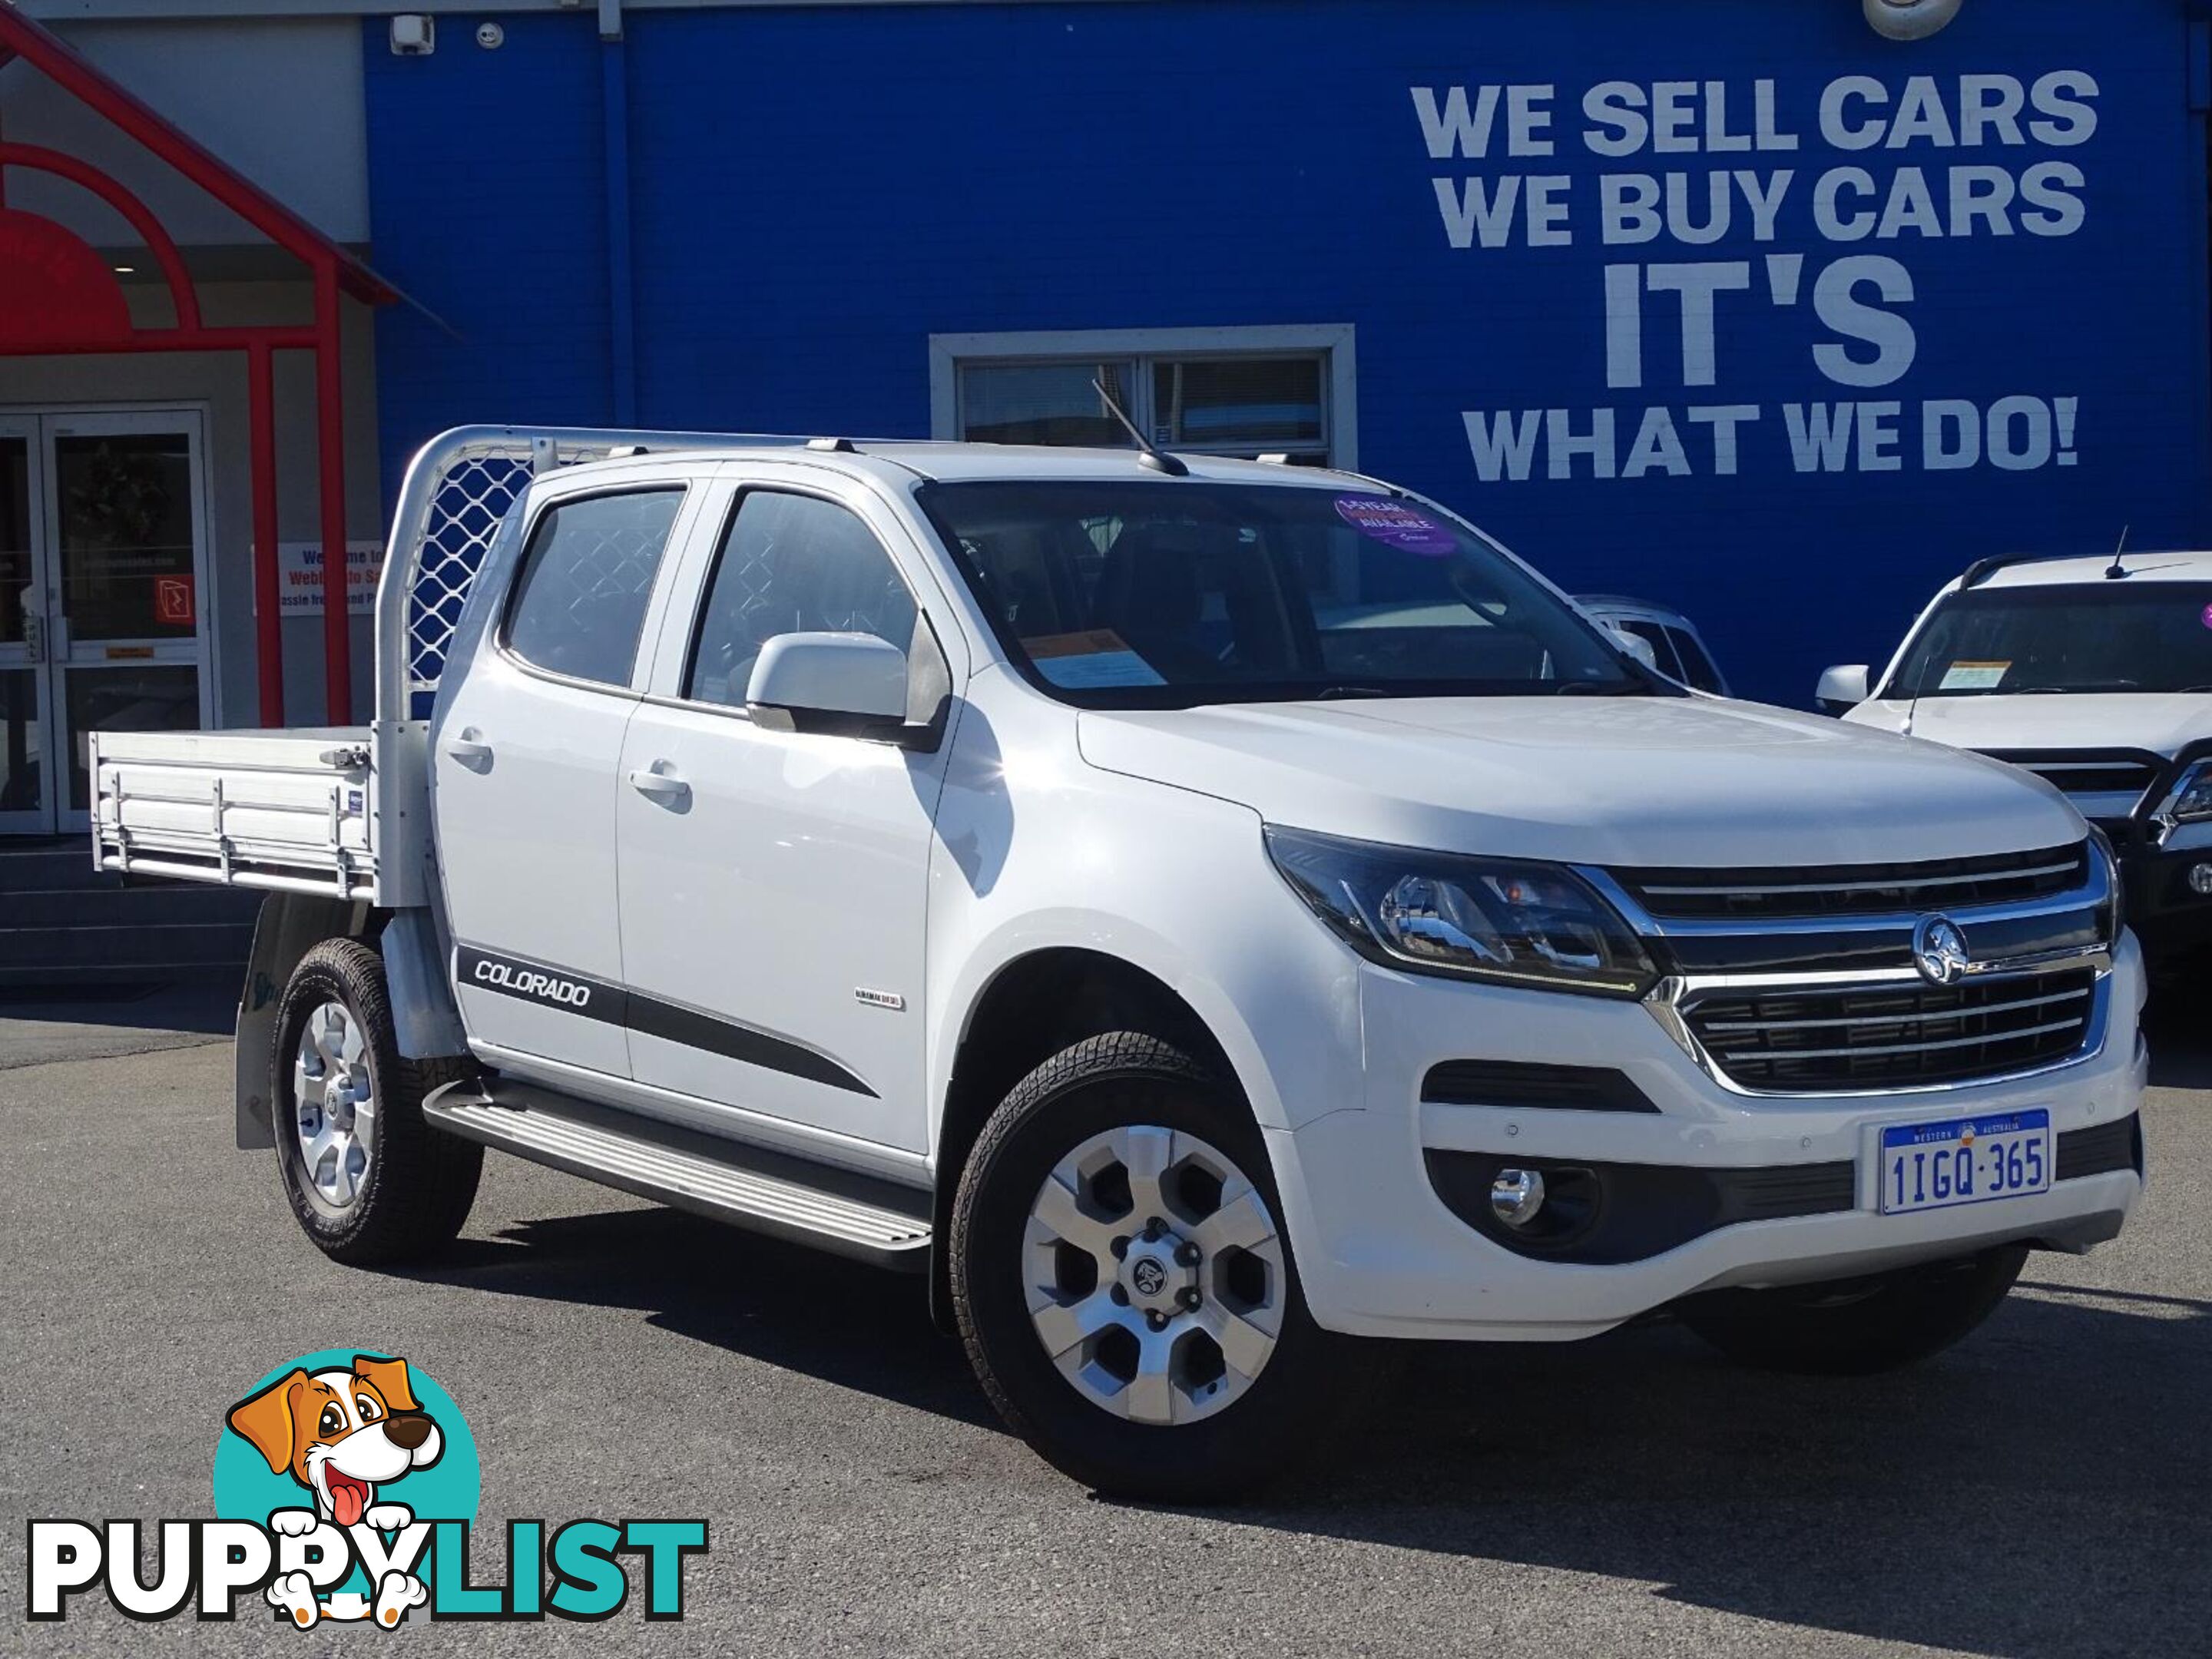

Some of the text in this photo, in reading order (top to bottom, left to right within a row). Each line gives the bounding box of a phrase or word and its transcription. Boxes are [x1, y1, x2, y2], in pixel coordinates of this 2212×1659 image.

[1409, 70, 2100, 158] WE SELL CARS
[1432, 161, 2086, 248] WE BUY CARS
[1604, 253, 1917, 388] IT'S
[1462, 395, 2078, 482] WHAT WE DO!
[475, 960, 591, 1007] COLORADO
[1913, 1122, 2020, 1143] WESTERN AUSTRALIA
